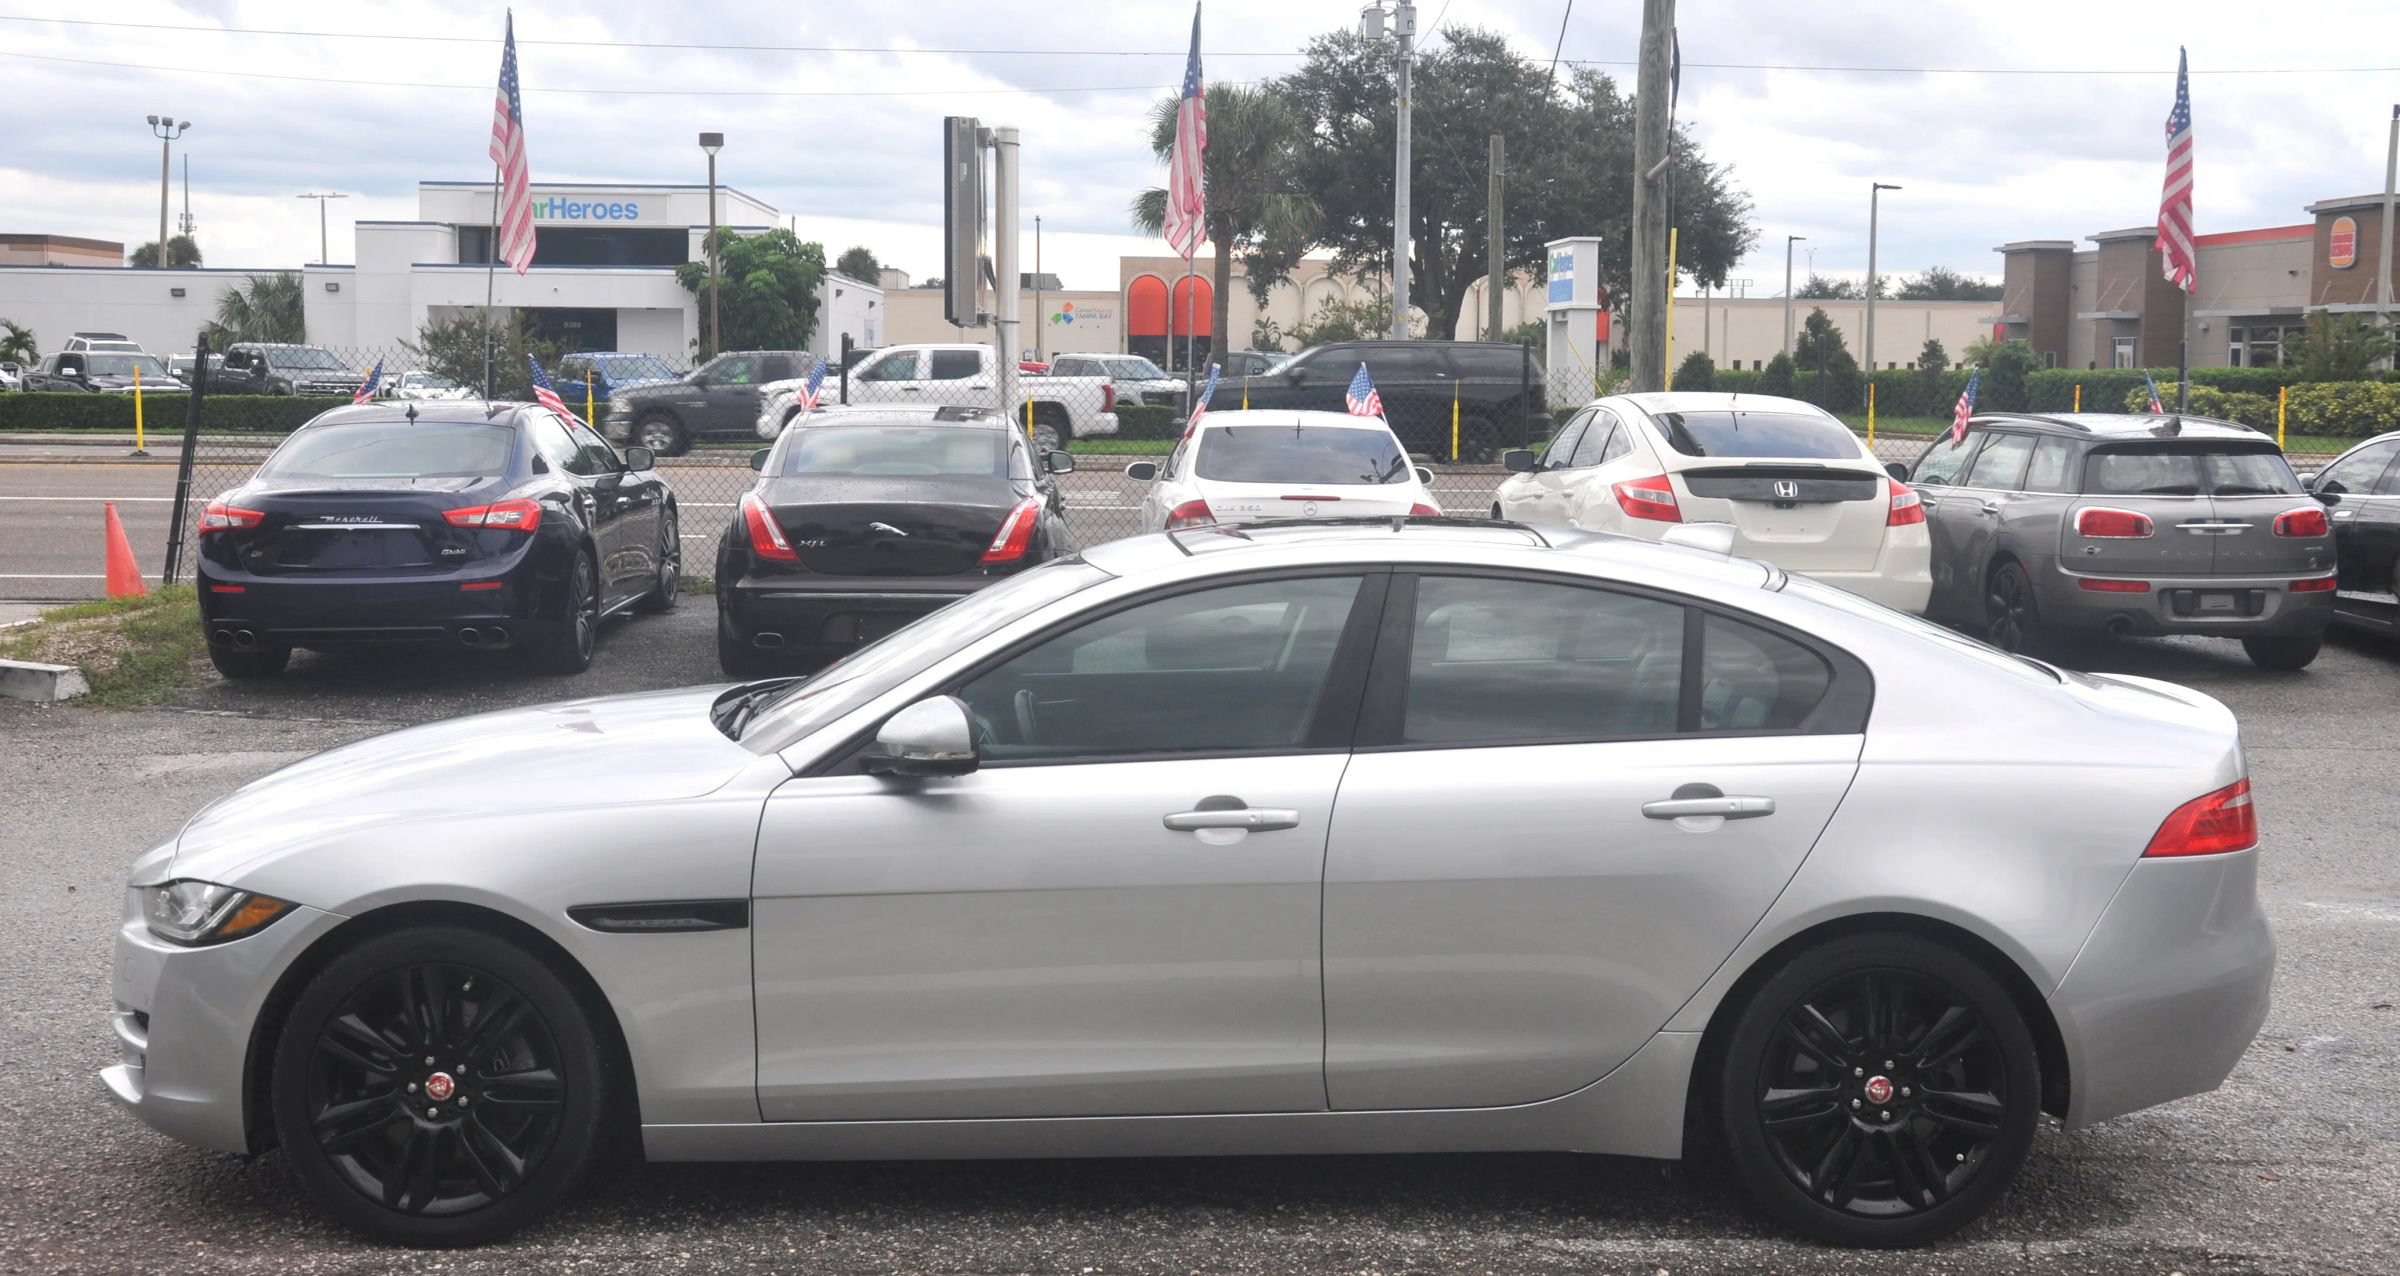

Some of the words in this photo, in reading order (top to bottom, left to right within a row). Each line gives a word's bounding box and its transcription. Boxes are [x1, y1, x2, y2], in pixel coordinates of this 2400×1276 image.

[531, 197, 639, 220] arHeroes
[1075, 312, 1098, 320] TAMPA
[1098, 312, 1113, 320] BAY
